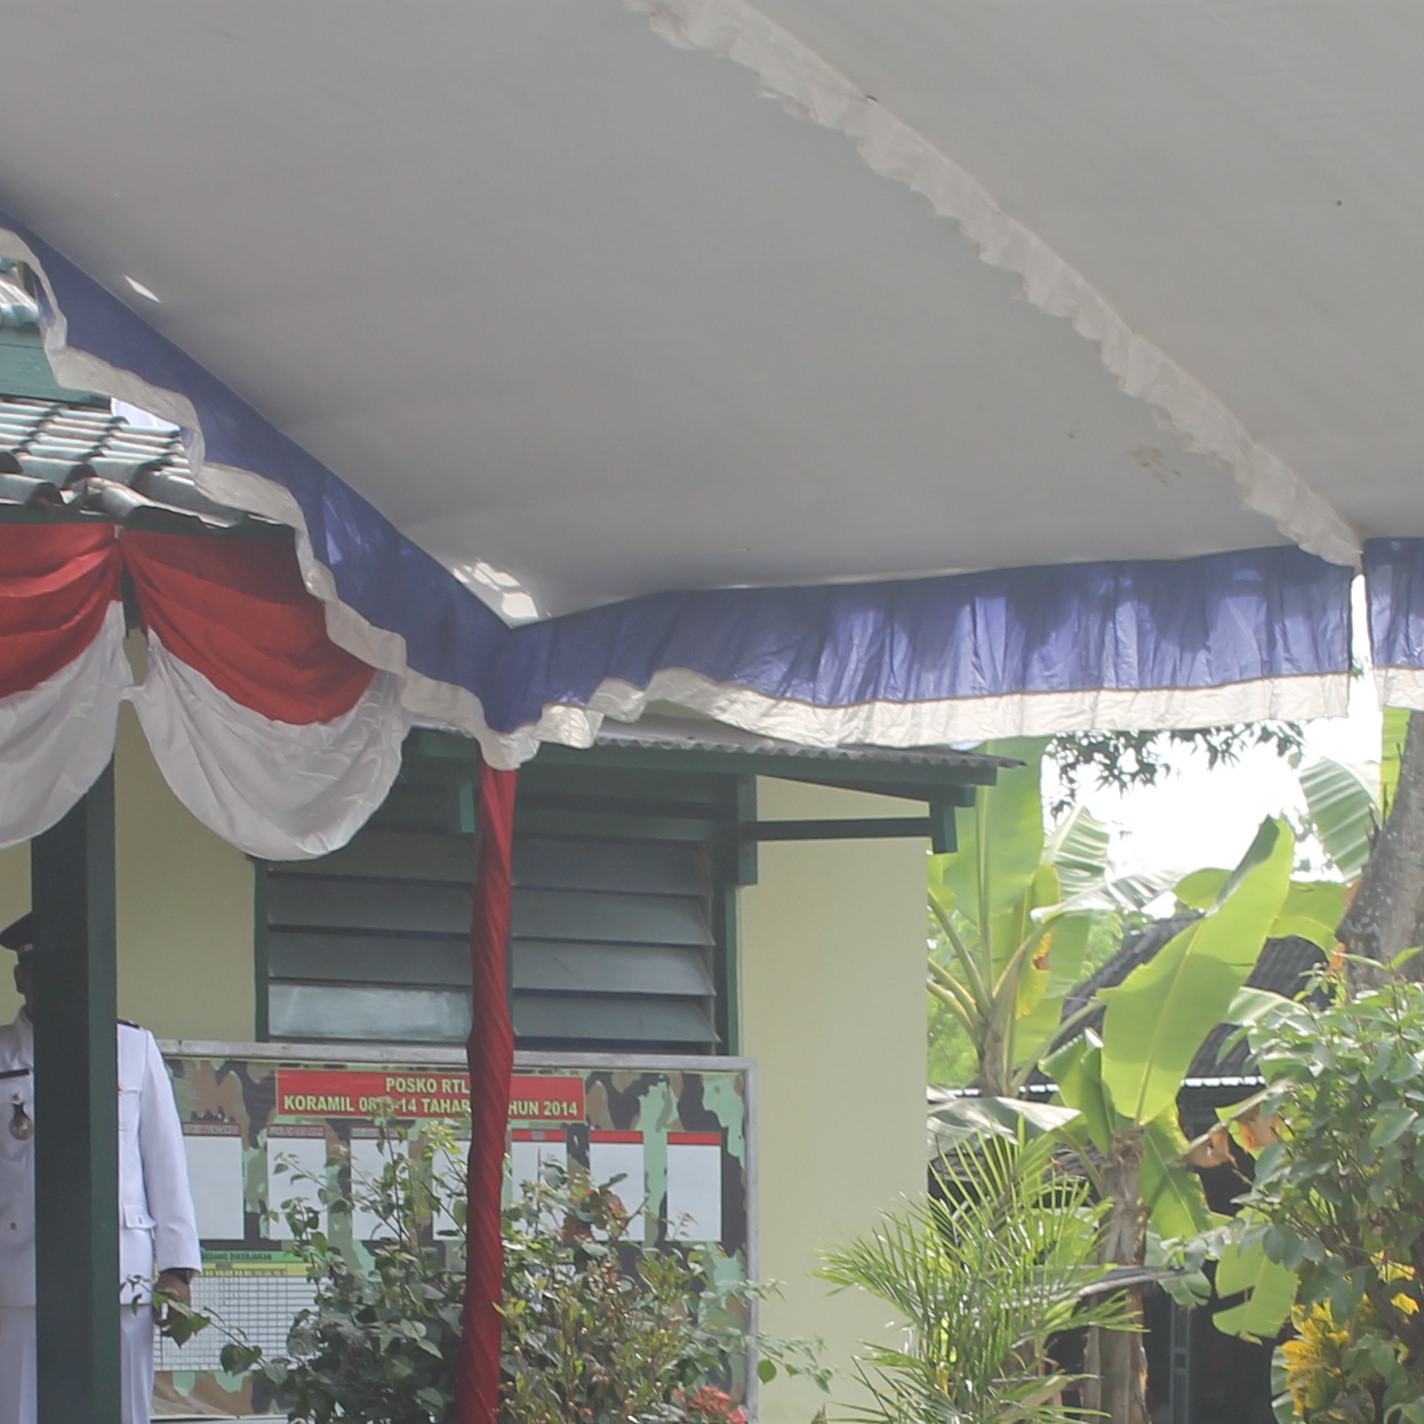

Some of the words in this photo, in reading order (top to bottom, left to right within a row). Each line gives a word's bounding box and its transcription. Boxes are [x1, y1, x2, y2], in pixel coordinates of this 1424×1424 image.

[386, 1077, 437, 1094] POSKO
[284, 1095, 355, 1112] KORAMIL
[544, 1101, 578, 1117] 2014
